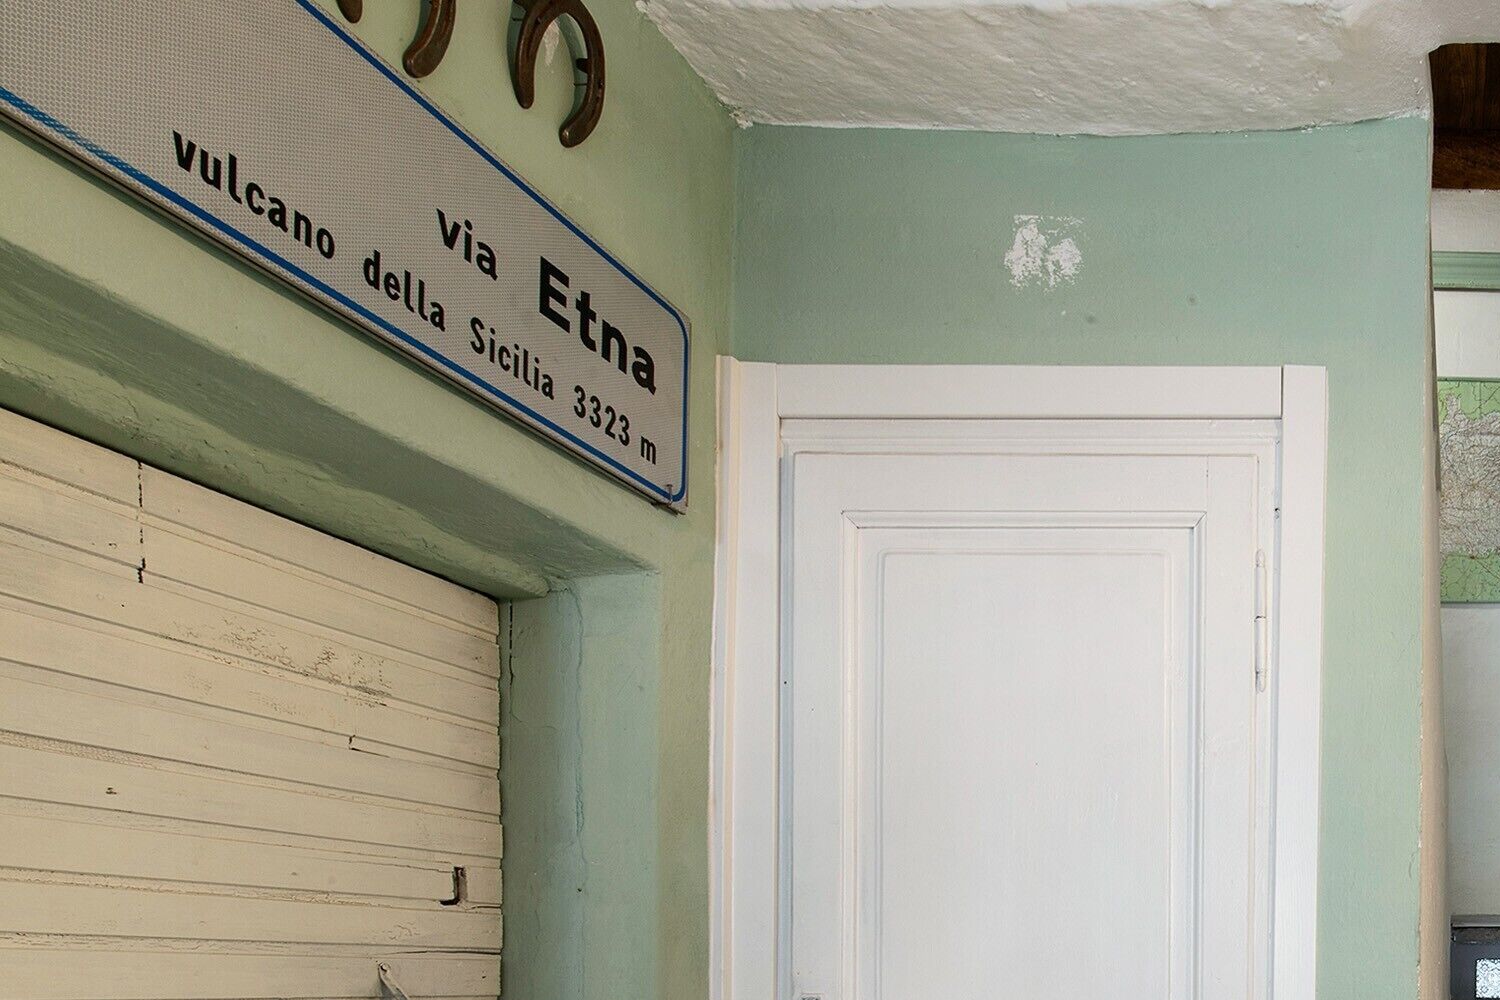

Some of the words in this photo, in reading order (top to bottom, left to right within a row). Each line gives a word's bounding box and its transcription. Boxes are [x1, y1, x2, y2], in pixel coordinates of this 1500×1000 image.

[172, 130, 335, 260] vulcano
[362, 249, 446, 332] della
[470, 316, 555, 401] Sicilia
[573, 384, 630, 447] 3323
[640, 436, 657, 465] m
[436, 207, 498, 280] via
[538, 255, 657, 395] Etna
